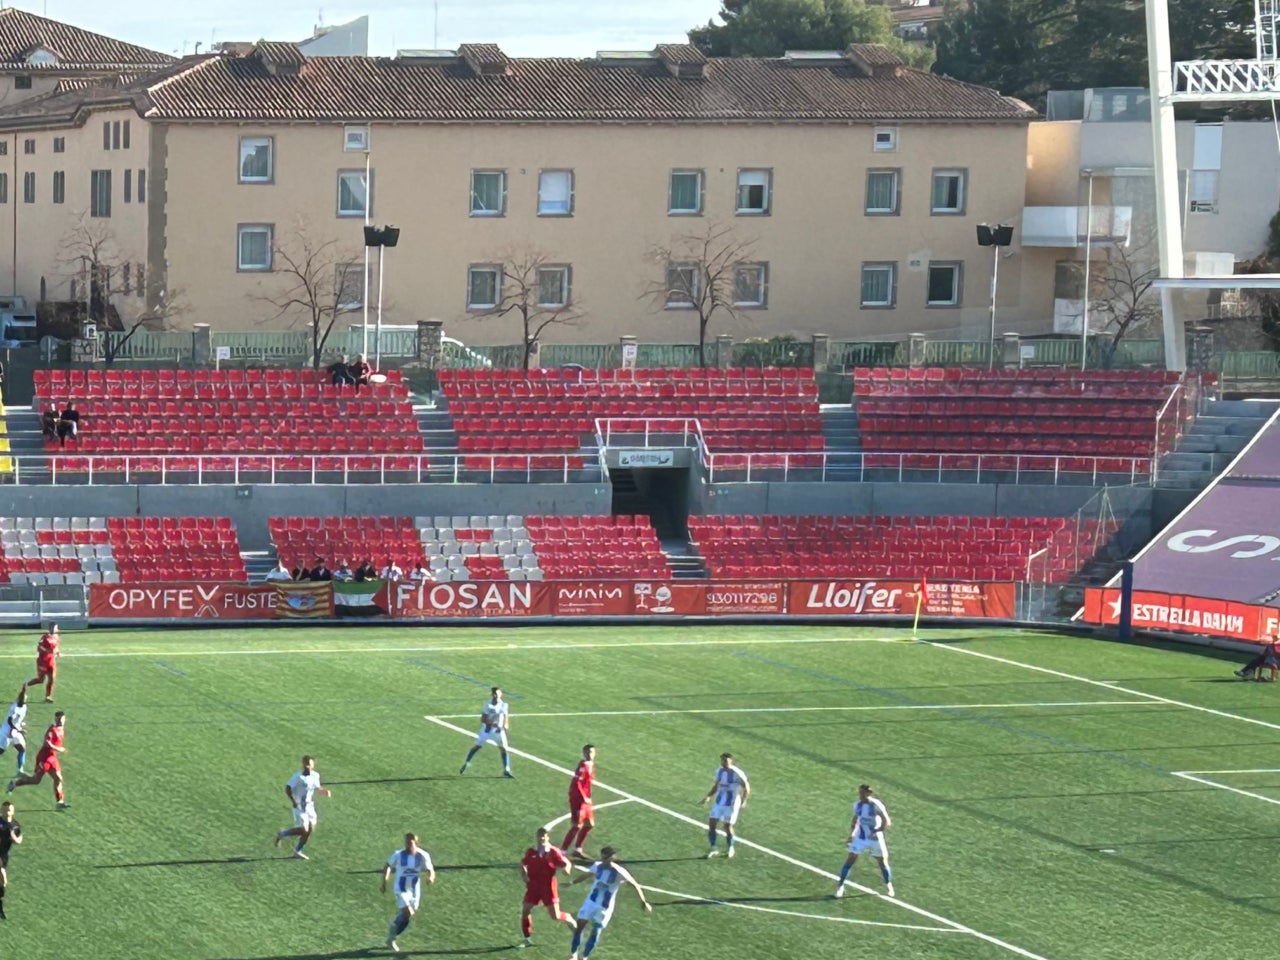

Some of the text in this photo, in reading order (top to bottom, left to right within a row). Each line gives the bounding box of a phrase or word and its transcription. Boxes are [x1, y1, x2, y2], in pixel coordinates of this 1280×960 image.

[396, 582, 531, 610] FIOSAN
[806, 582, 903, 613] Lloifer
[1133, 602, 1244, 633] ESTRELLA DAMM
